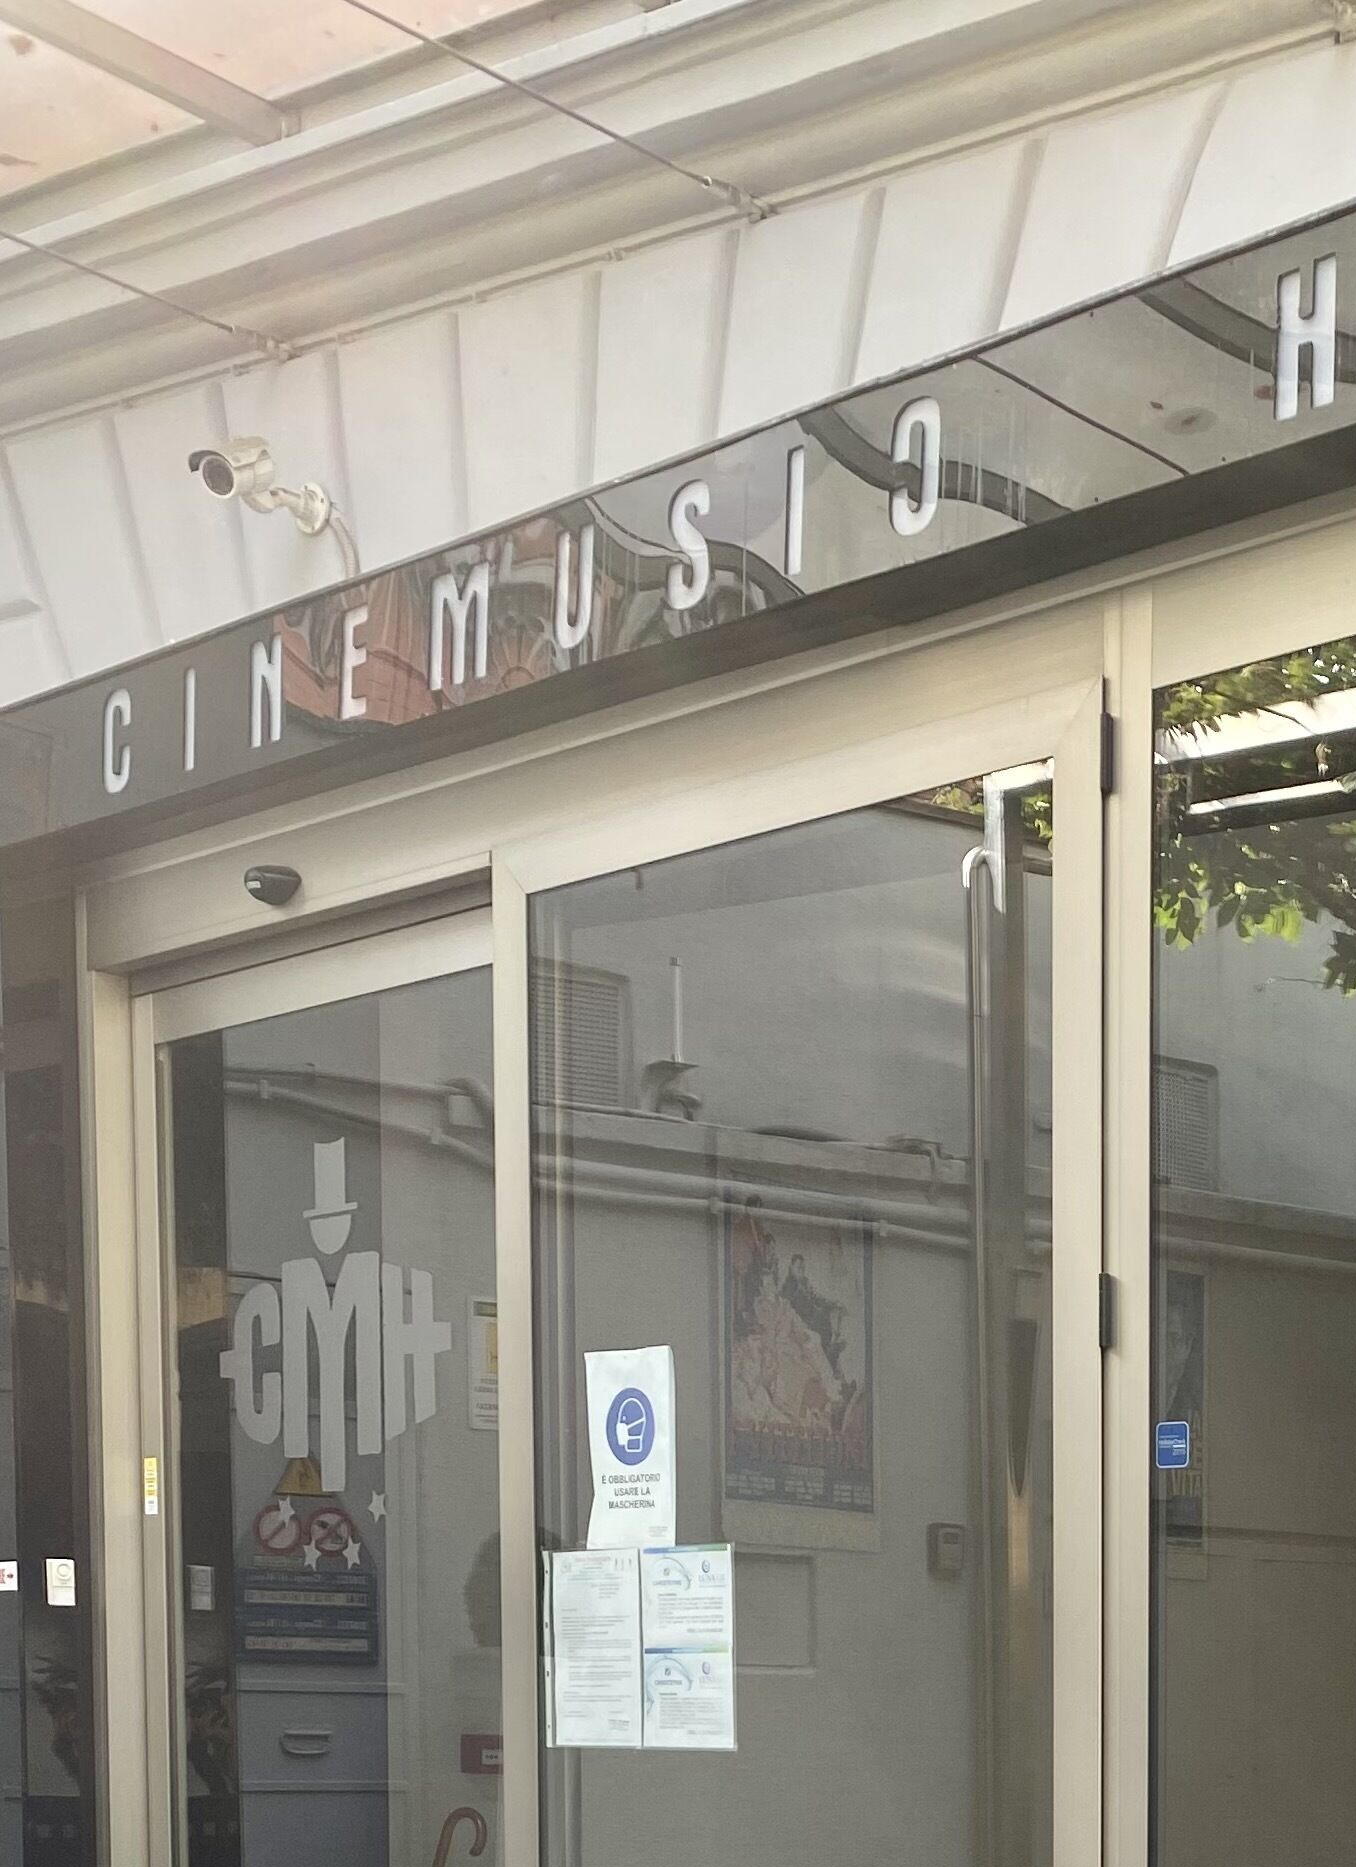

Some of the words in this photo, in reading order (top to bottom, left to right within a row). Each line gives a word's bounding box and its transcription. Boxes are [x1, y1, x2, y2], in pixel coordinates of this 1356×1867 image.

[608, 1473, 661, 1484] OBBLIGATORIO
[614, 1486, 639, 1497] USARE
[640, 1486, 651, 1497] LA
[608, 1498, 656, 1510] MASCHERINA
